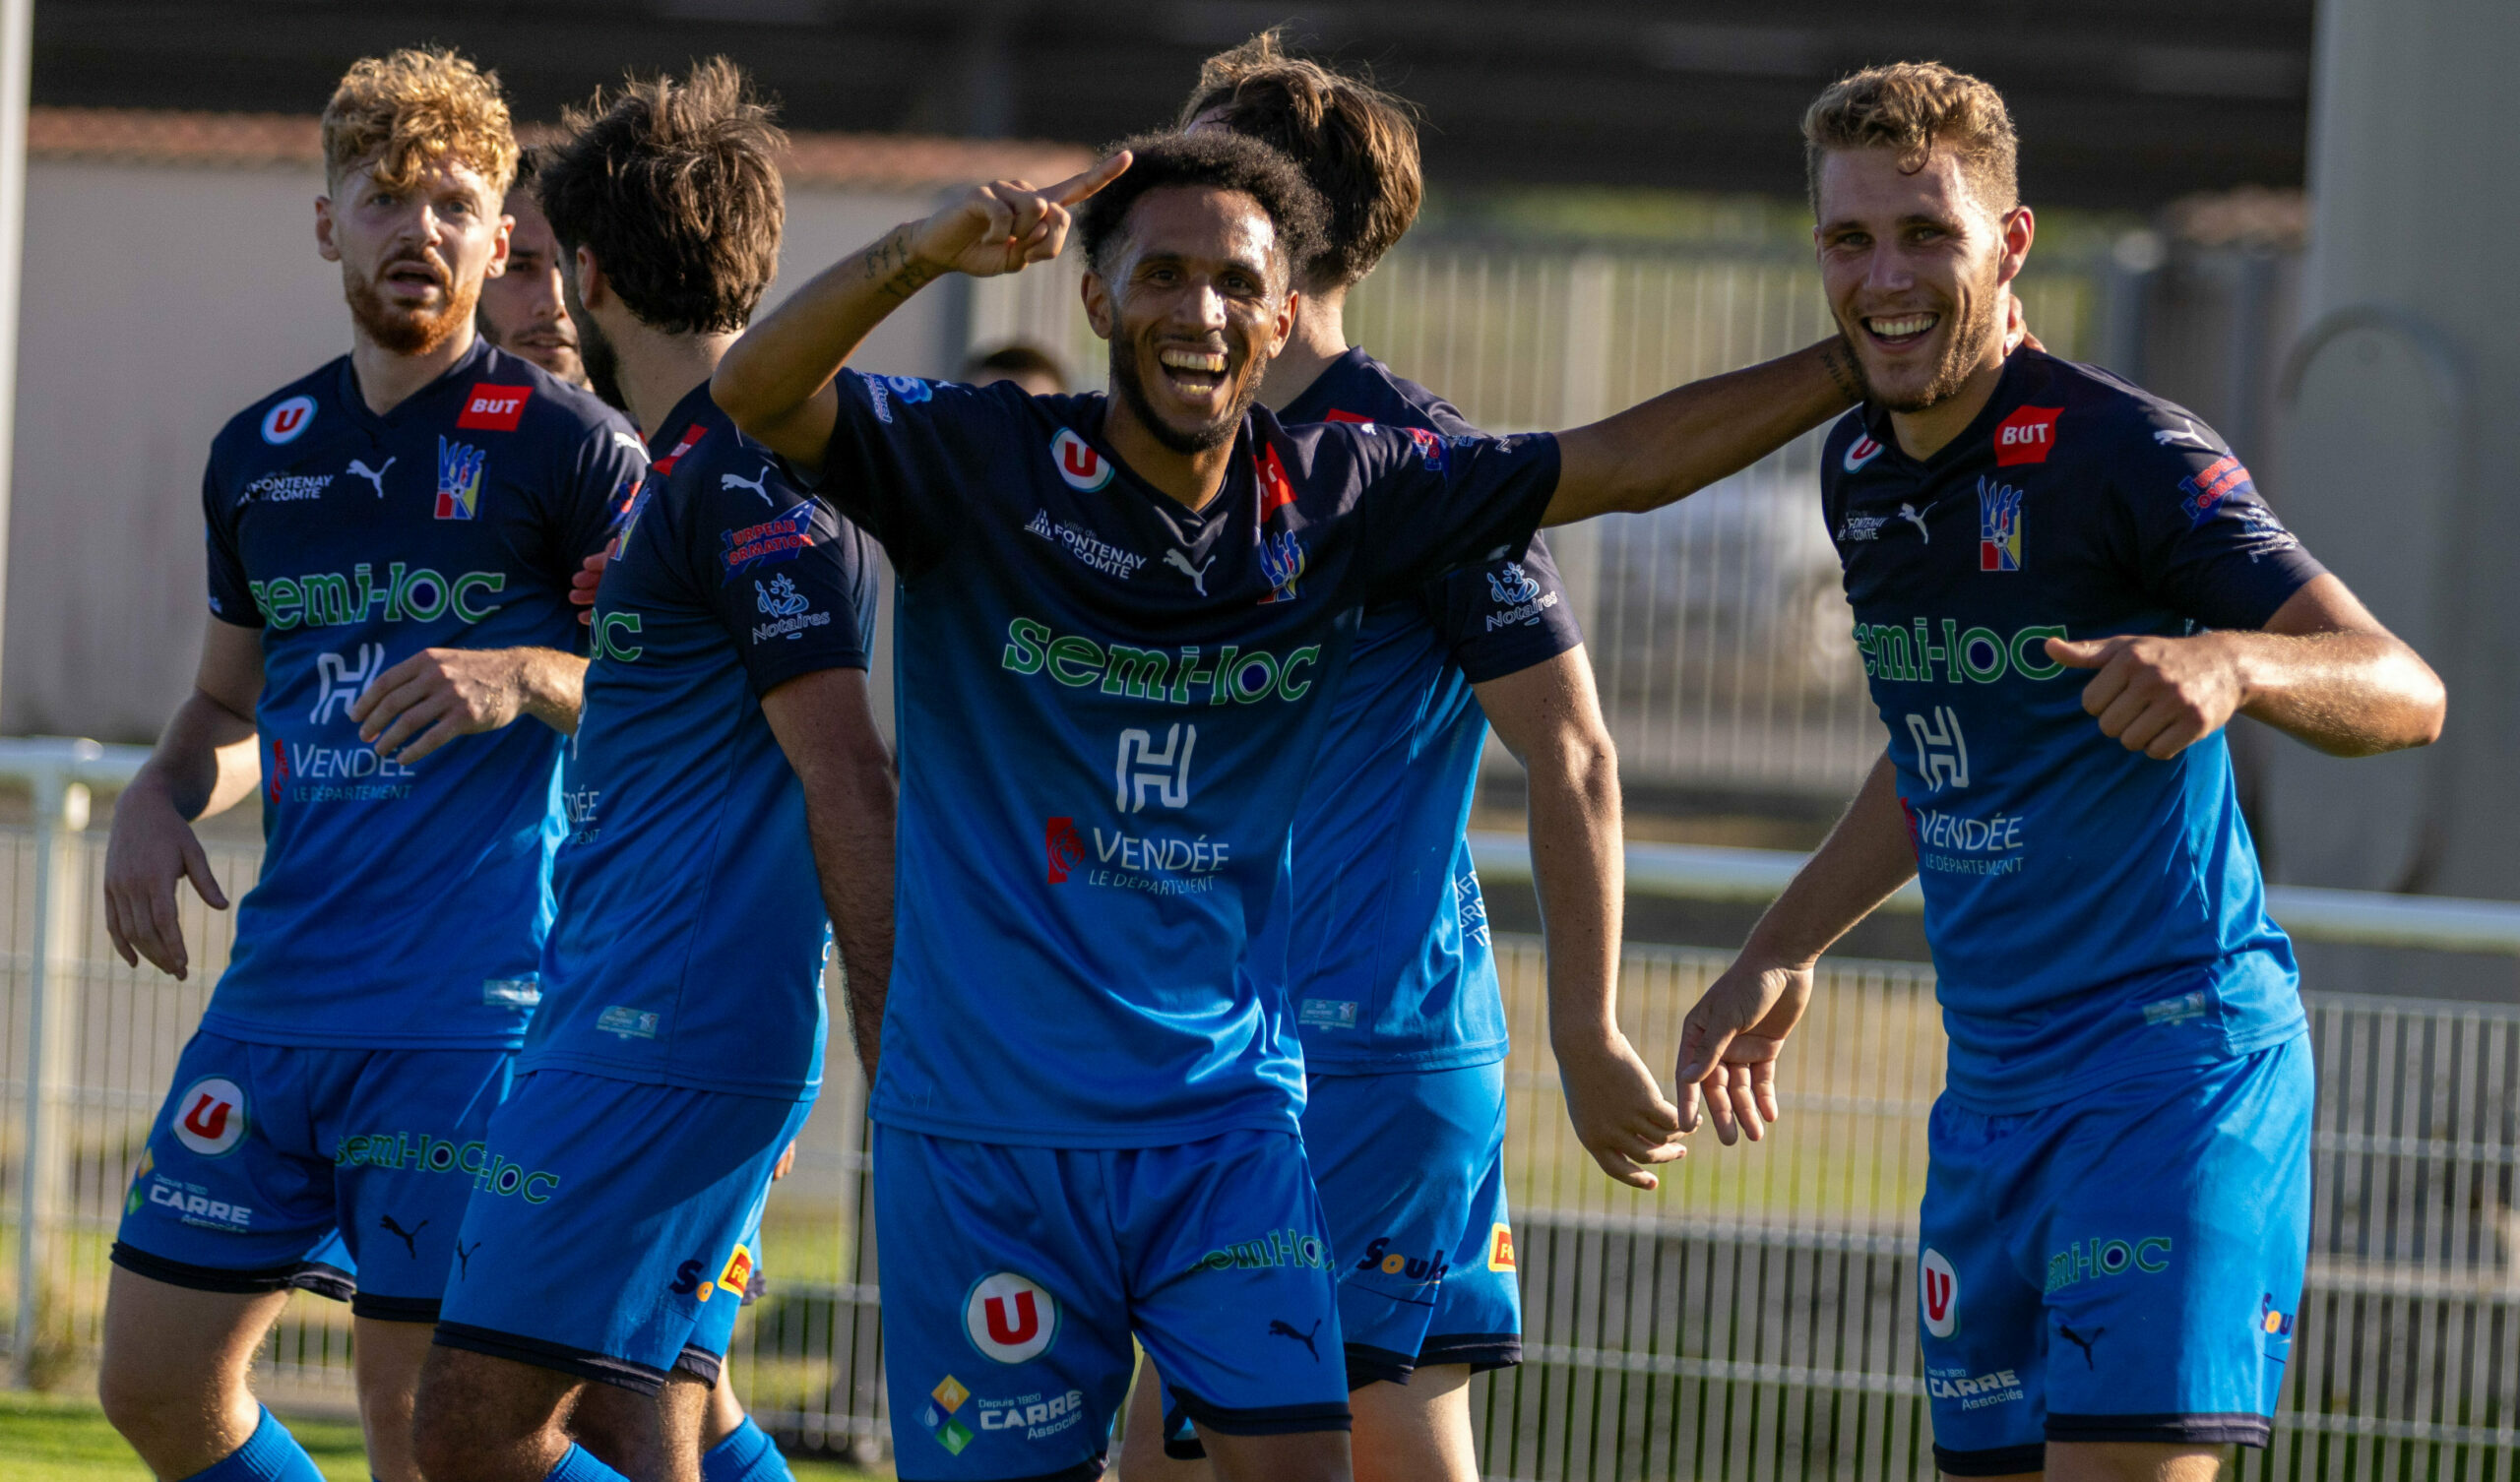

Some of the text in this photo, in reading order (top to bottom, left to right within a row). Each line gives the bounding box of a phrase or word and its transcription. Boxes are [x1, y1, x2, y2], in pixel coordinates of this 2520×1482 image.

[273, 406, 305, 433] U
[470, 398, 521, 414] BUT
[2001, 422, 2049, 445] BUT
[1064, 441, 1100, 477] U
[272, 486, 322, 502] COMTE
[1054, 524, 1147, 570] FONTENAY
[1074, 547, 1131, 580] COMTE
[248, 562, 506, 630] semi-loc
[1486, 590, 1558, 632] Notaires
[752, 609, 831, 646] Notaires
[1002, 617, 1322, 706] semi-loc
[1852, 617, 2069, 684] emi-loc
[1094, 827, 1229, 872] VENDÉE
[1916, 807, 2024, 851] VENDÉE
[1089, 869, 1107, 886] LE
[184, 1093, 233, 1140] U
[150, 1184, 253, 1226] CARRE
[1926, 1267, 1951, 1322] U
[984, 1290, 1039, 1346] U
[978, 1392, 1041, 1409] Depuis 1920
[1929, 1369, 2021, 1398] CARRE
[1962, 1389, 2024, 1412] Associés
[980, 1389, 1083, 1430] CARRE
